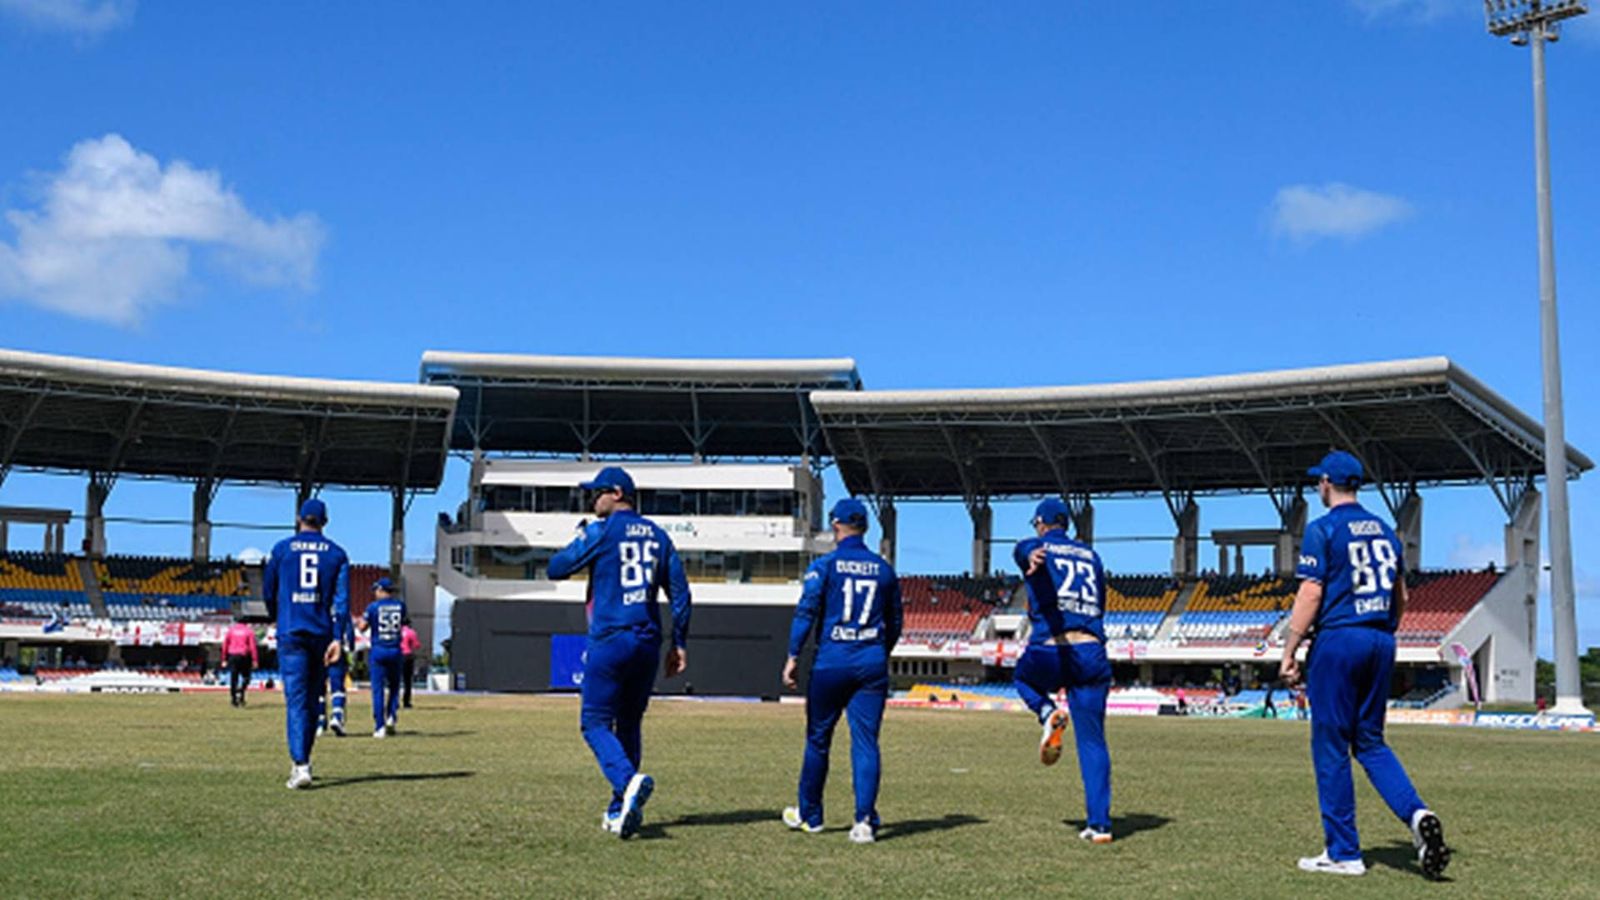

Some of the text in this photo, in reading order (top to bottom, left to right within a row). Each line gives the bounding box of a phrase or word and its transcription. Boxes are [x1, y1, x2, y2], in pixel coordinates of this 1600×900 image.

[300, 553, 319, 588] 6
[619, 540, 659, 588] 85
[836, 560, 879, 575] DUCKETT
[1054, 558, 1098, 602] 23
[1348, 539, 1397, 594] 88
[378, 611, 401, 632] 58
[842, 577, 877, 625] 17
